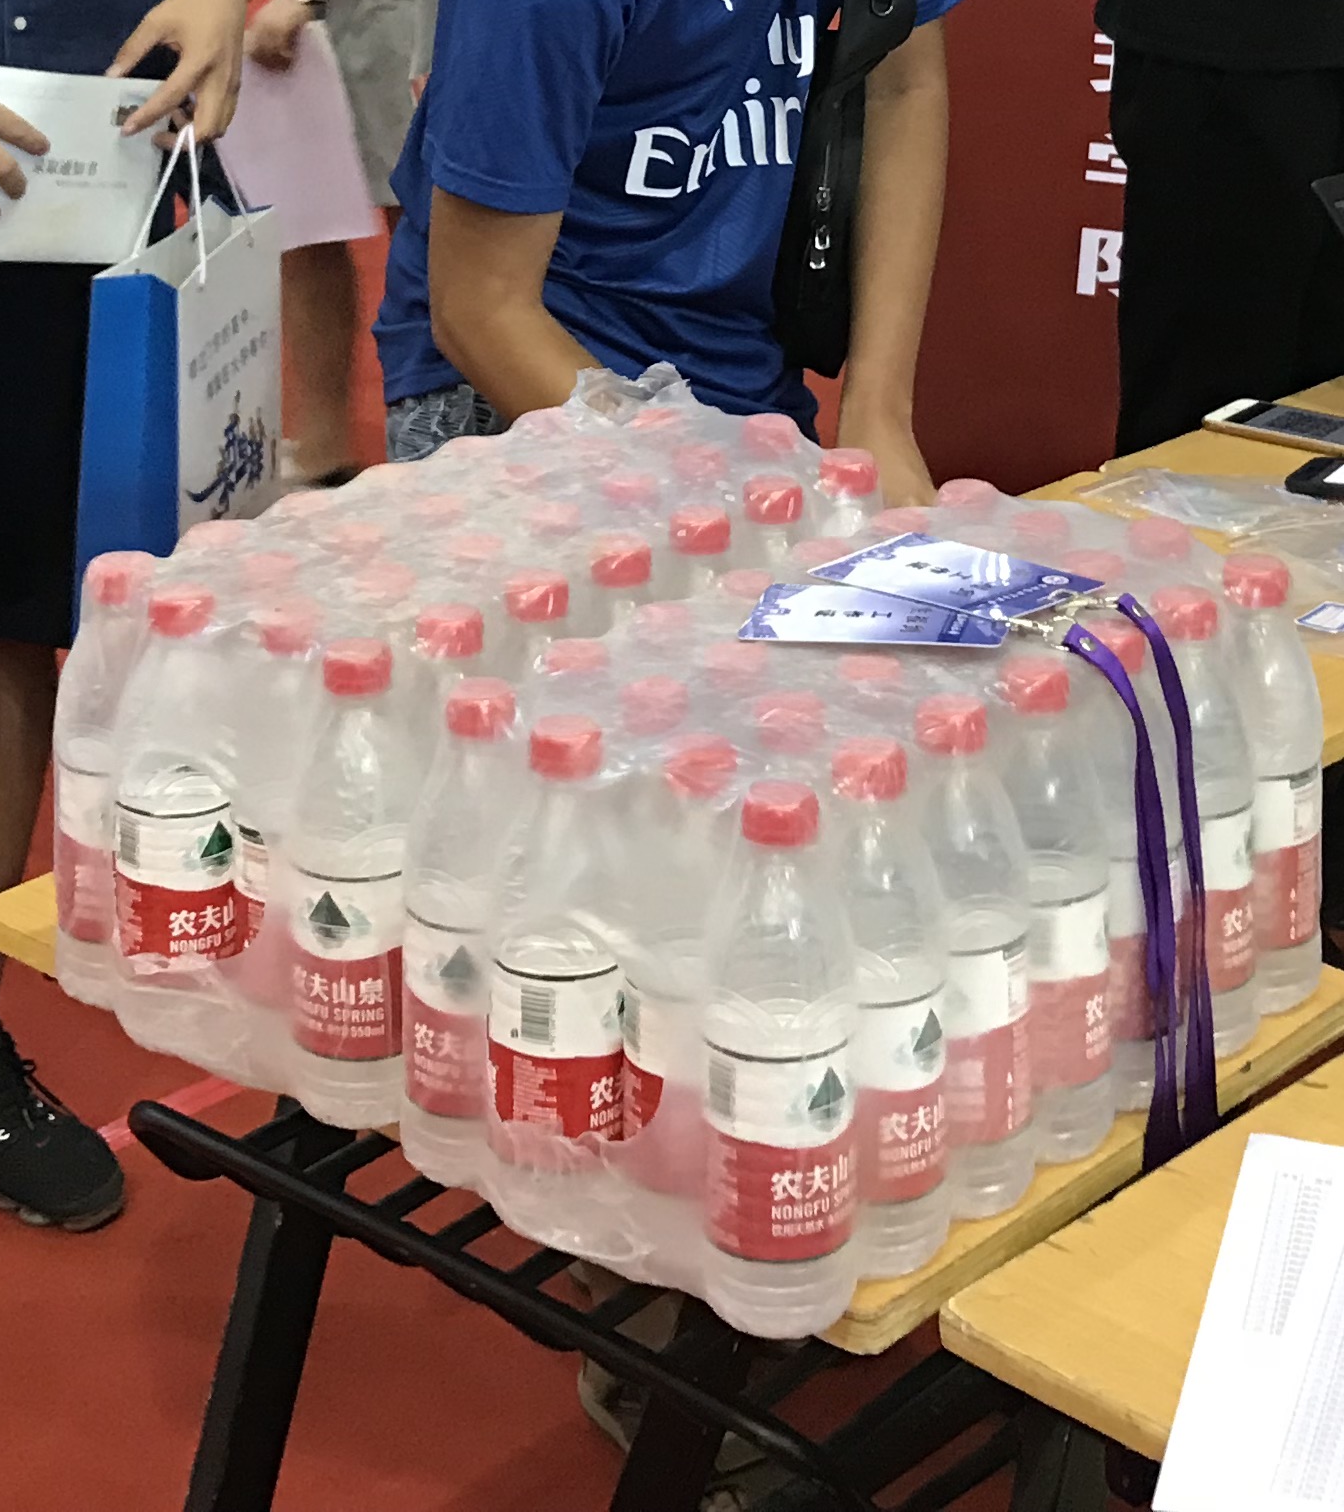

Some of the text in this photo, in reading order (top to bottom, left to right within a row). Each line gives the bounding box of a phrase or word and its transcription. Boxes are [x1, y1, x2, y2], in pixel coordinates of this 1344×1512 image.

[767, 12, 815, 78] ly
[624, 78, 806, 198] Emir
[170, 932, 222, 954] NONGFU
[333, 1006, 385, 1023] SPRING
[771, 1197, 830, 1220] NONGFU
